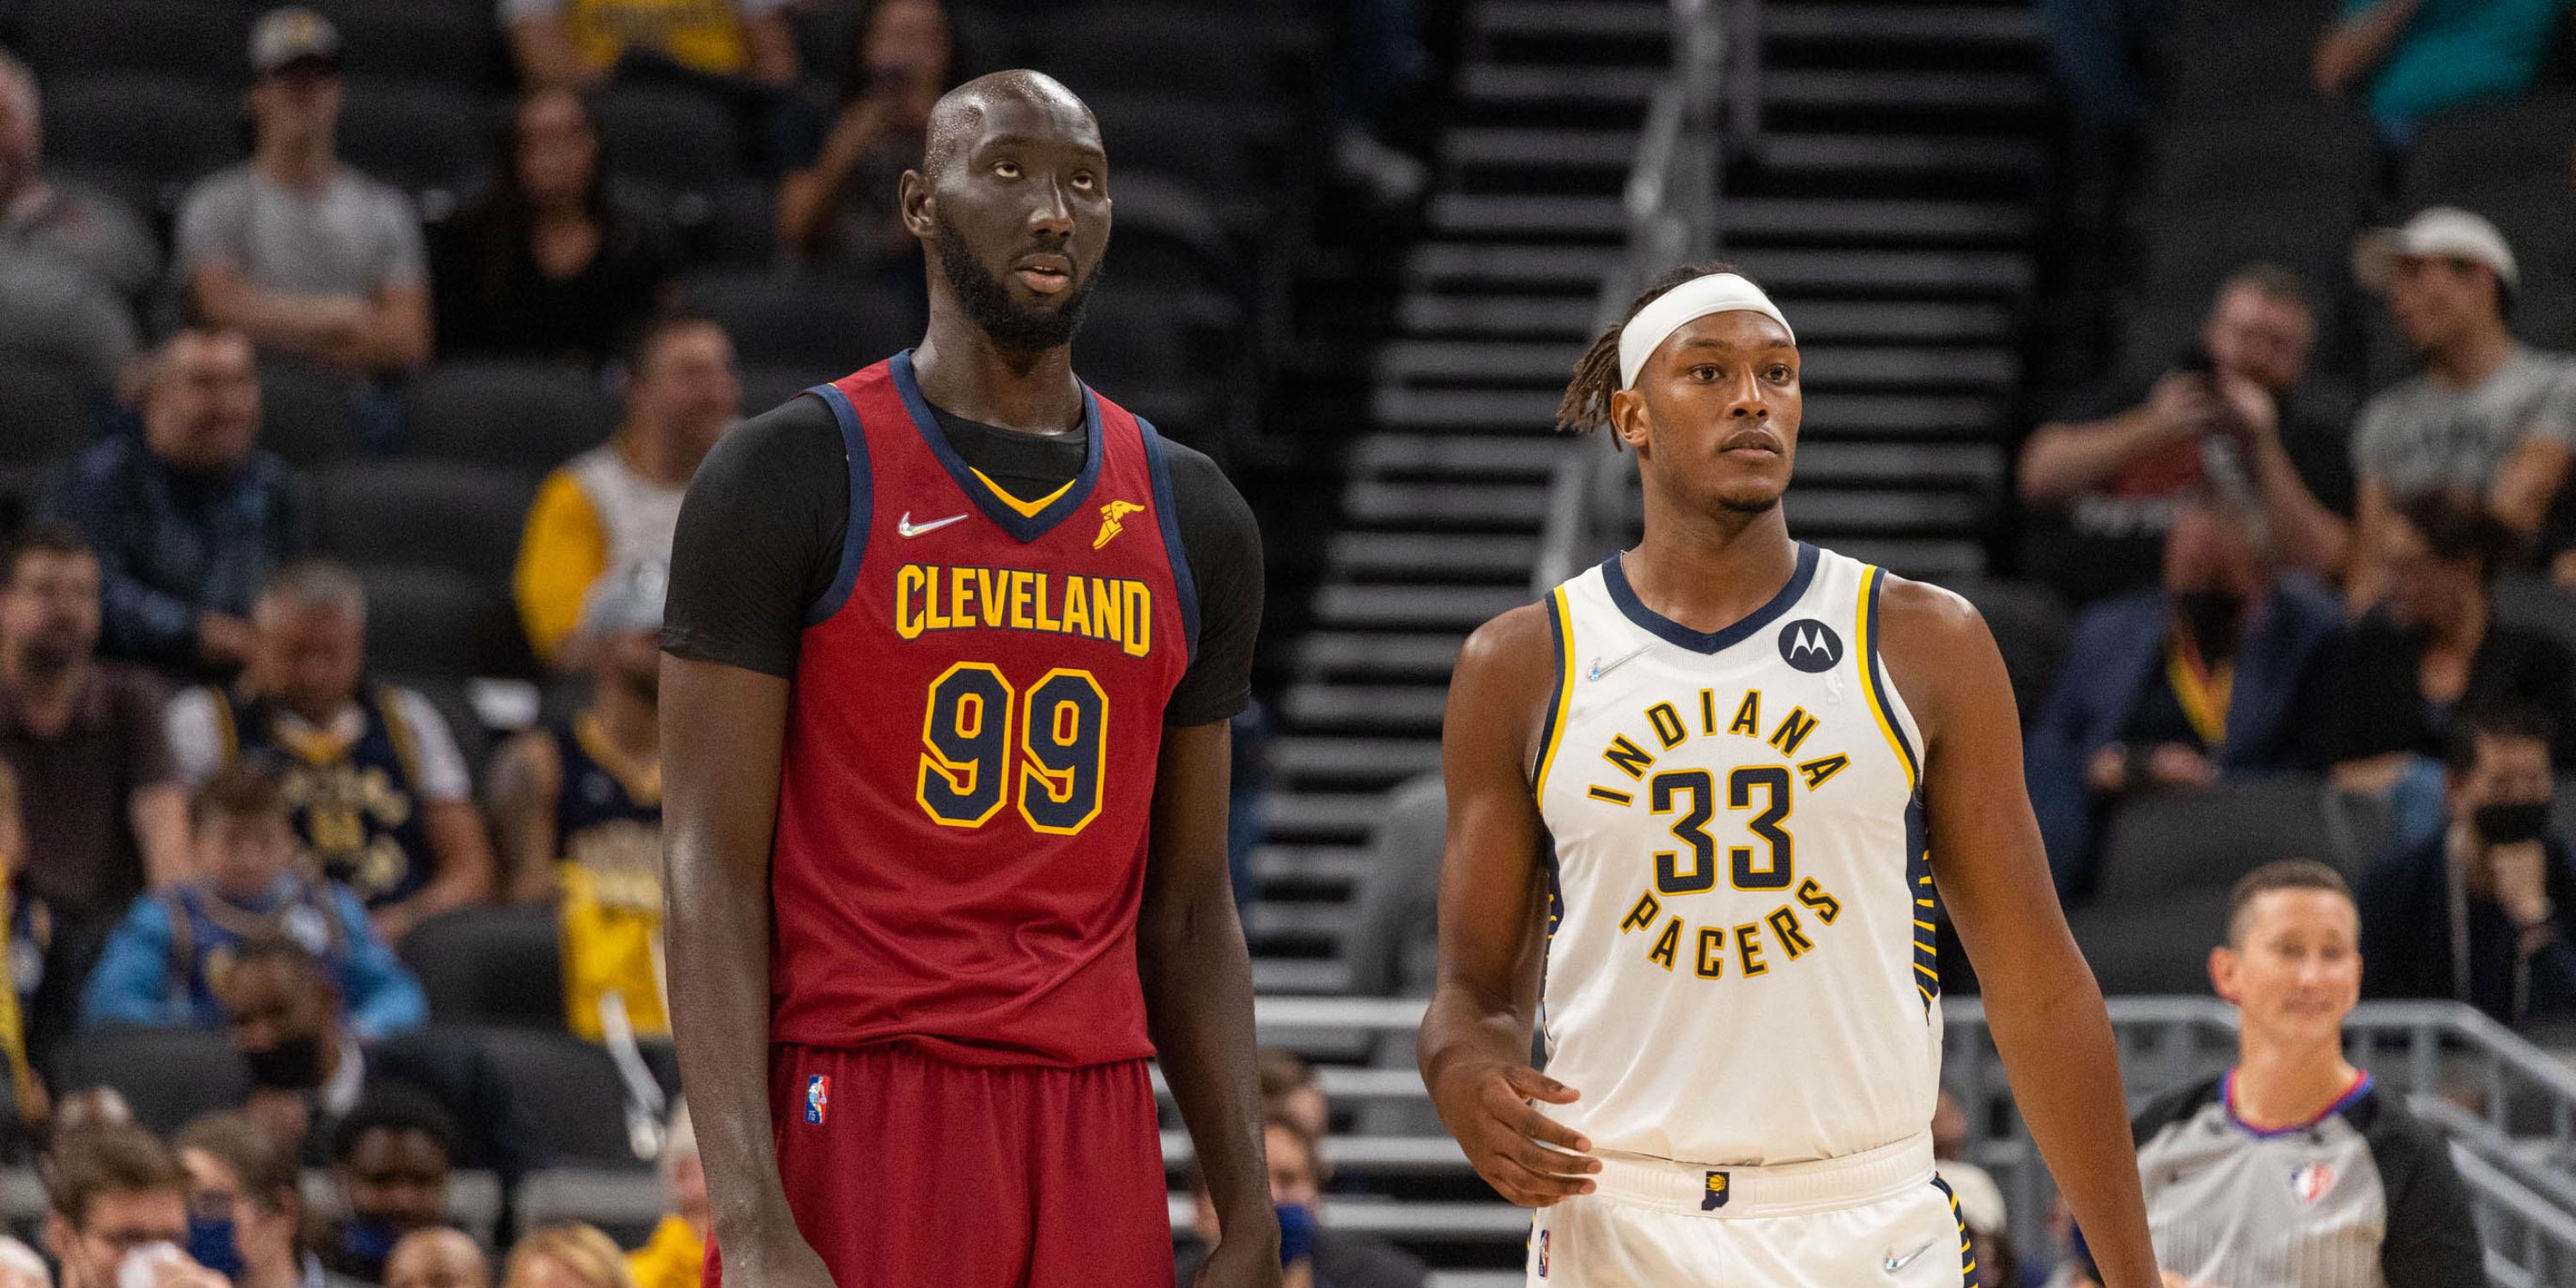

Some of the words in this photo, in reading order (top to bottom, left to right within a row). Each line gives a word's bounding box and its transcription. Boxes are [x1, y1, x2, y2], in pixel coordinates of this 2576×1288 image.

[895, 562, 1152, 659] CLEVELAND
[916, 661, 1109, 836] 99
[1588, 688, 1851, 807] INDIANA
[1649, 764, 1795, 896] 33
[1619, 876, 1842, 980] PACERS
